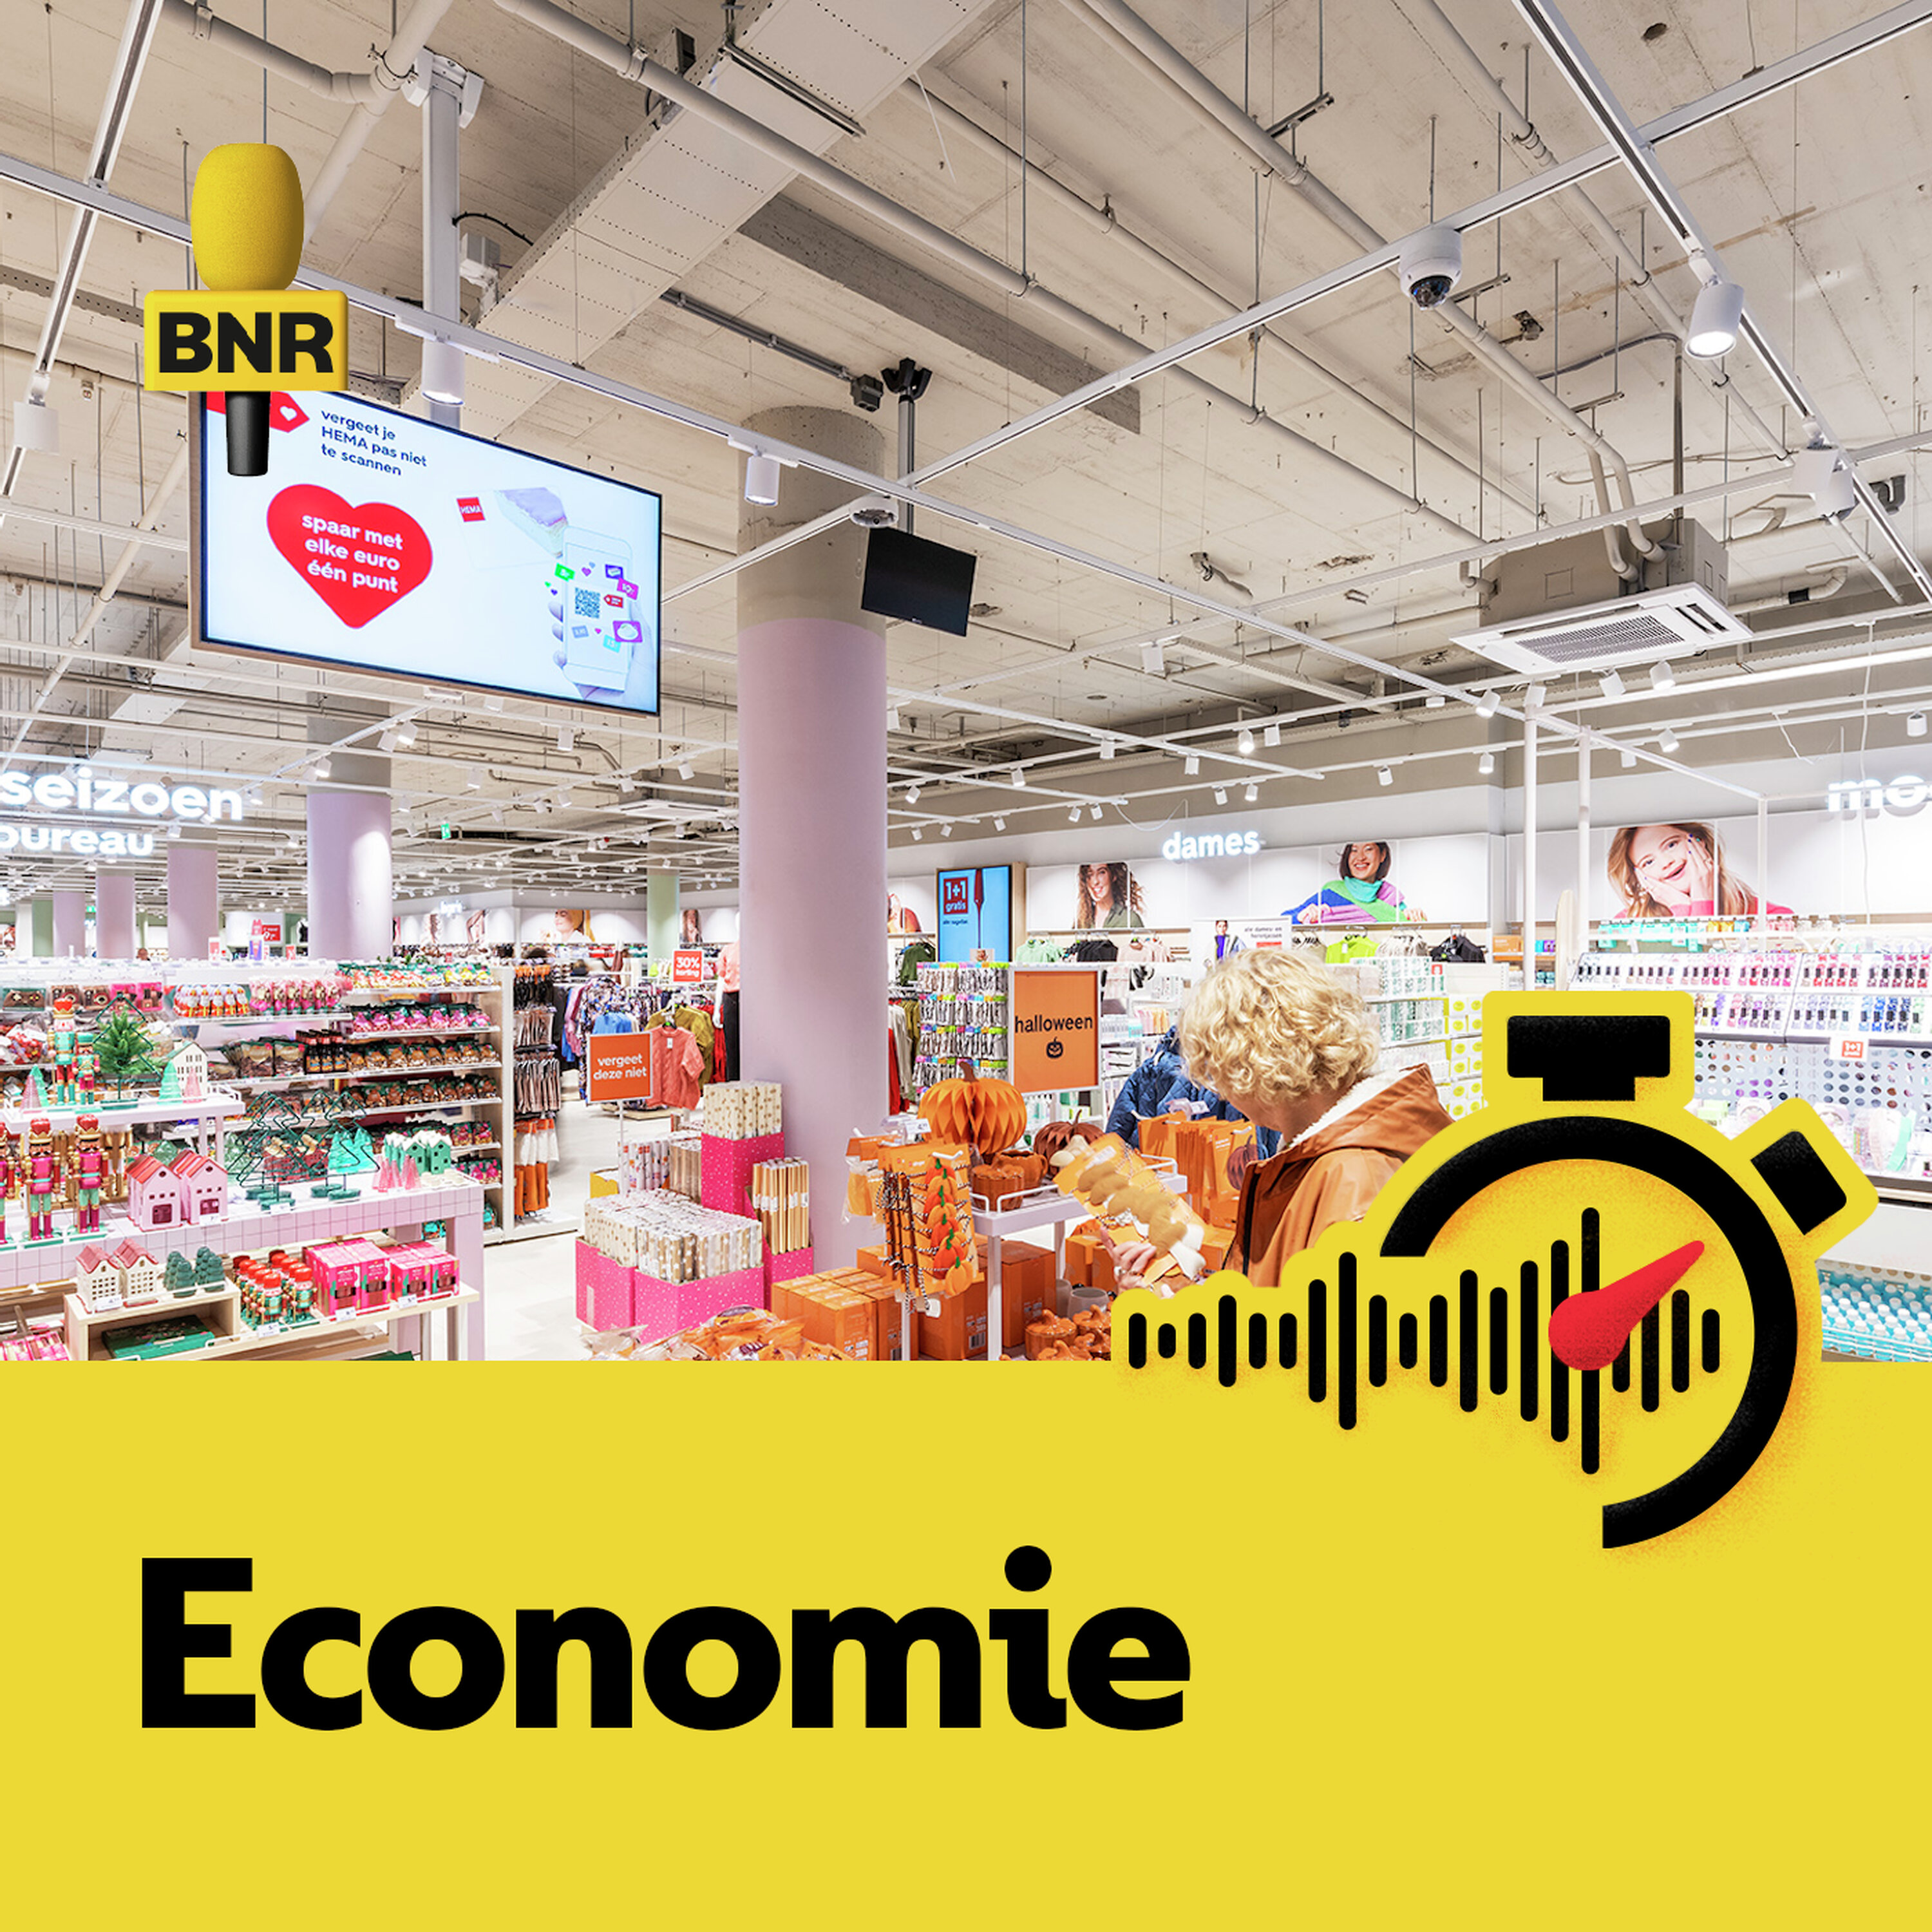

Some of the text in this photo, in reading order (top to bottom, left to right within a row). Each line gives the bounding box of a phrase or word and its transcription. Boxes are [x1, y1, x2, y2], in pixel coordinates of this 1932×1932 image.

[321, 410, 395, 440] vergeet je
[321, 443, 401, 476] te scannen
[322, 426, 427, 467] HEMA pas niet
[301, 515, 403, 551] spaar met
[305, 538, 401, 571] elke euro
[307, 558, 399, 594] één punt
[0, 766, 243, 821] seizoen
[1162, 831, 1260, 861] dames
[945, 880, 966, 900] 1+1
[945, 900, 966, 913] gratis
[676, 956, 701, 969] 30%
[1015, 1014, 1093, 1033] halloween
[593, 1066, 647, 1081] deze niet
[597, 1053, 643, 1068] vergeet
